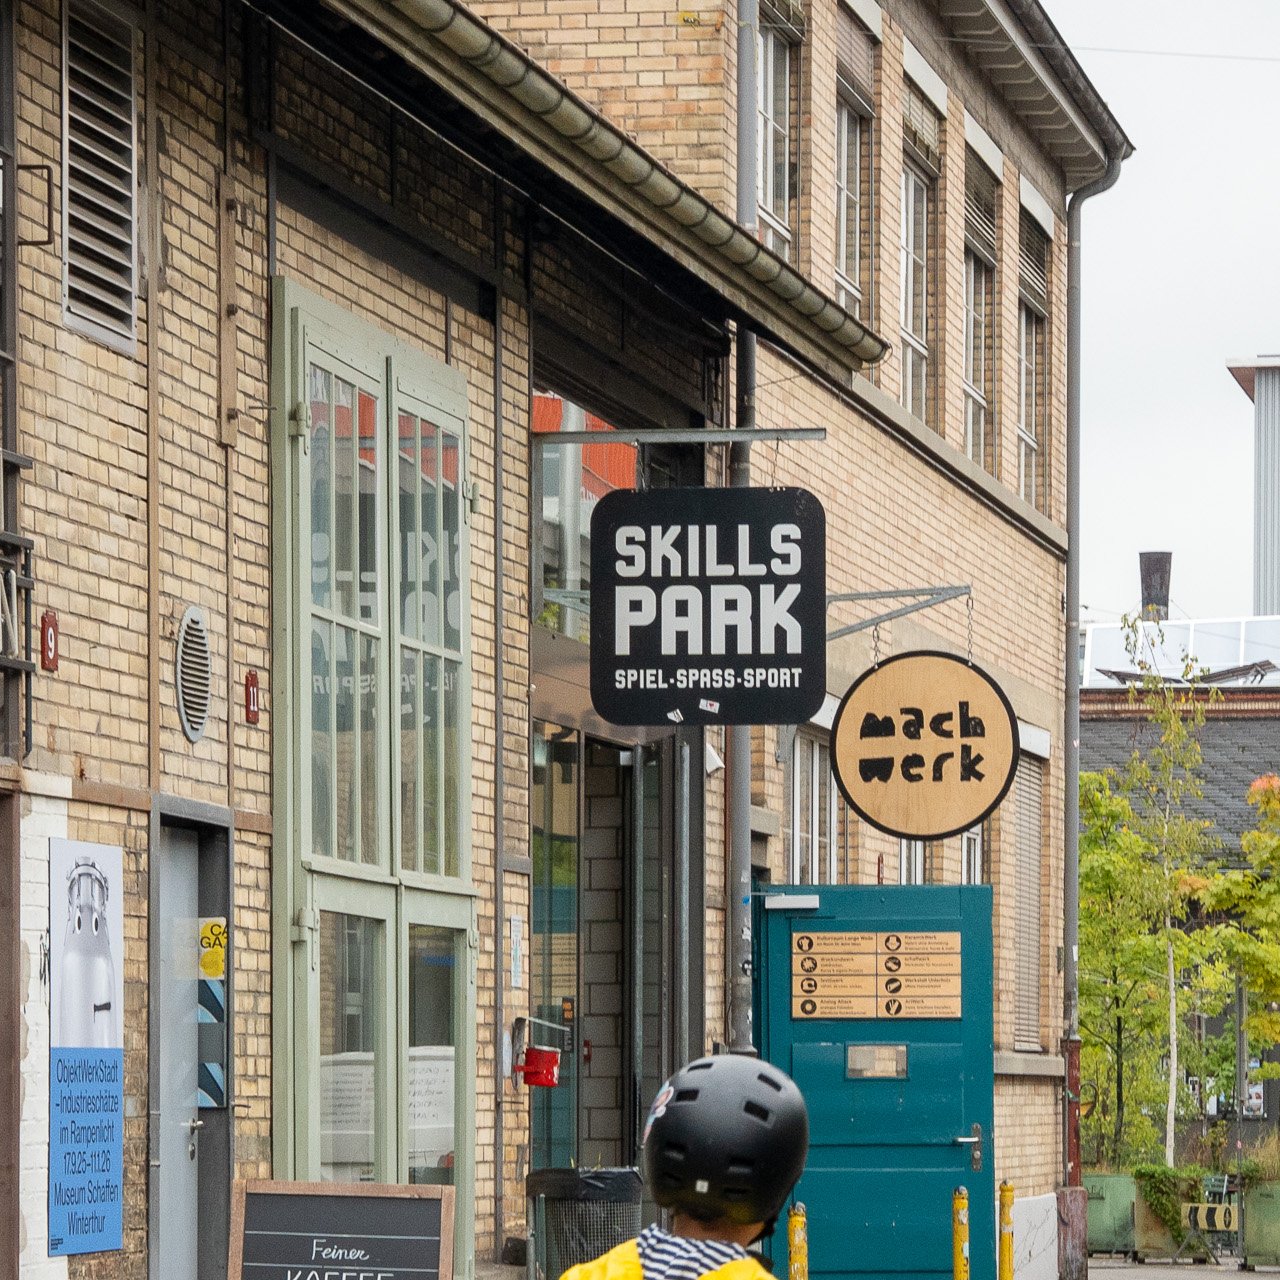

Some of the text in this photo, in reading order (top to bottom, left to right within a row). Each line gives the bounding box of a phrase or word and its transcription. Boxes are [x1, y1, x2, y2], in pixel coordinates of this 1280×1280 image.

[615, 523, 802, 578] SKILLS
[615, 583, 802, 656] PARK
[46, 627, 56, 660] 9
[859, 700, 986, 740] mach
[858, 743, 986, 784] werk
[56, 1058, 119, 1088] ObjektWerkStadt
[59, 1120, 115, 1148] im Rampenlicht
[54, 1179, 119, 1206] Museum Schaffen
[67, 1210, 106, 1236] Winterthur
[311, 1238, 370, 1261] Feiner
